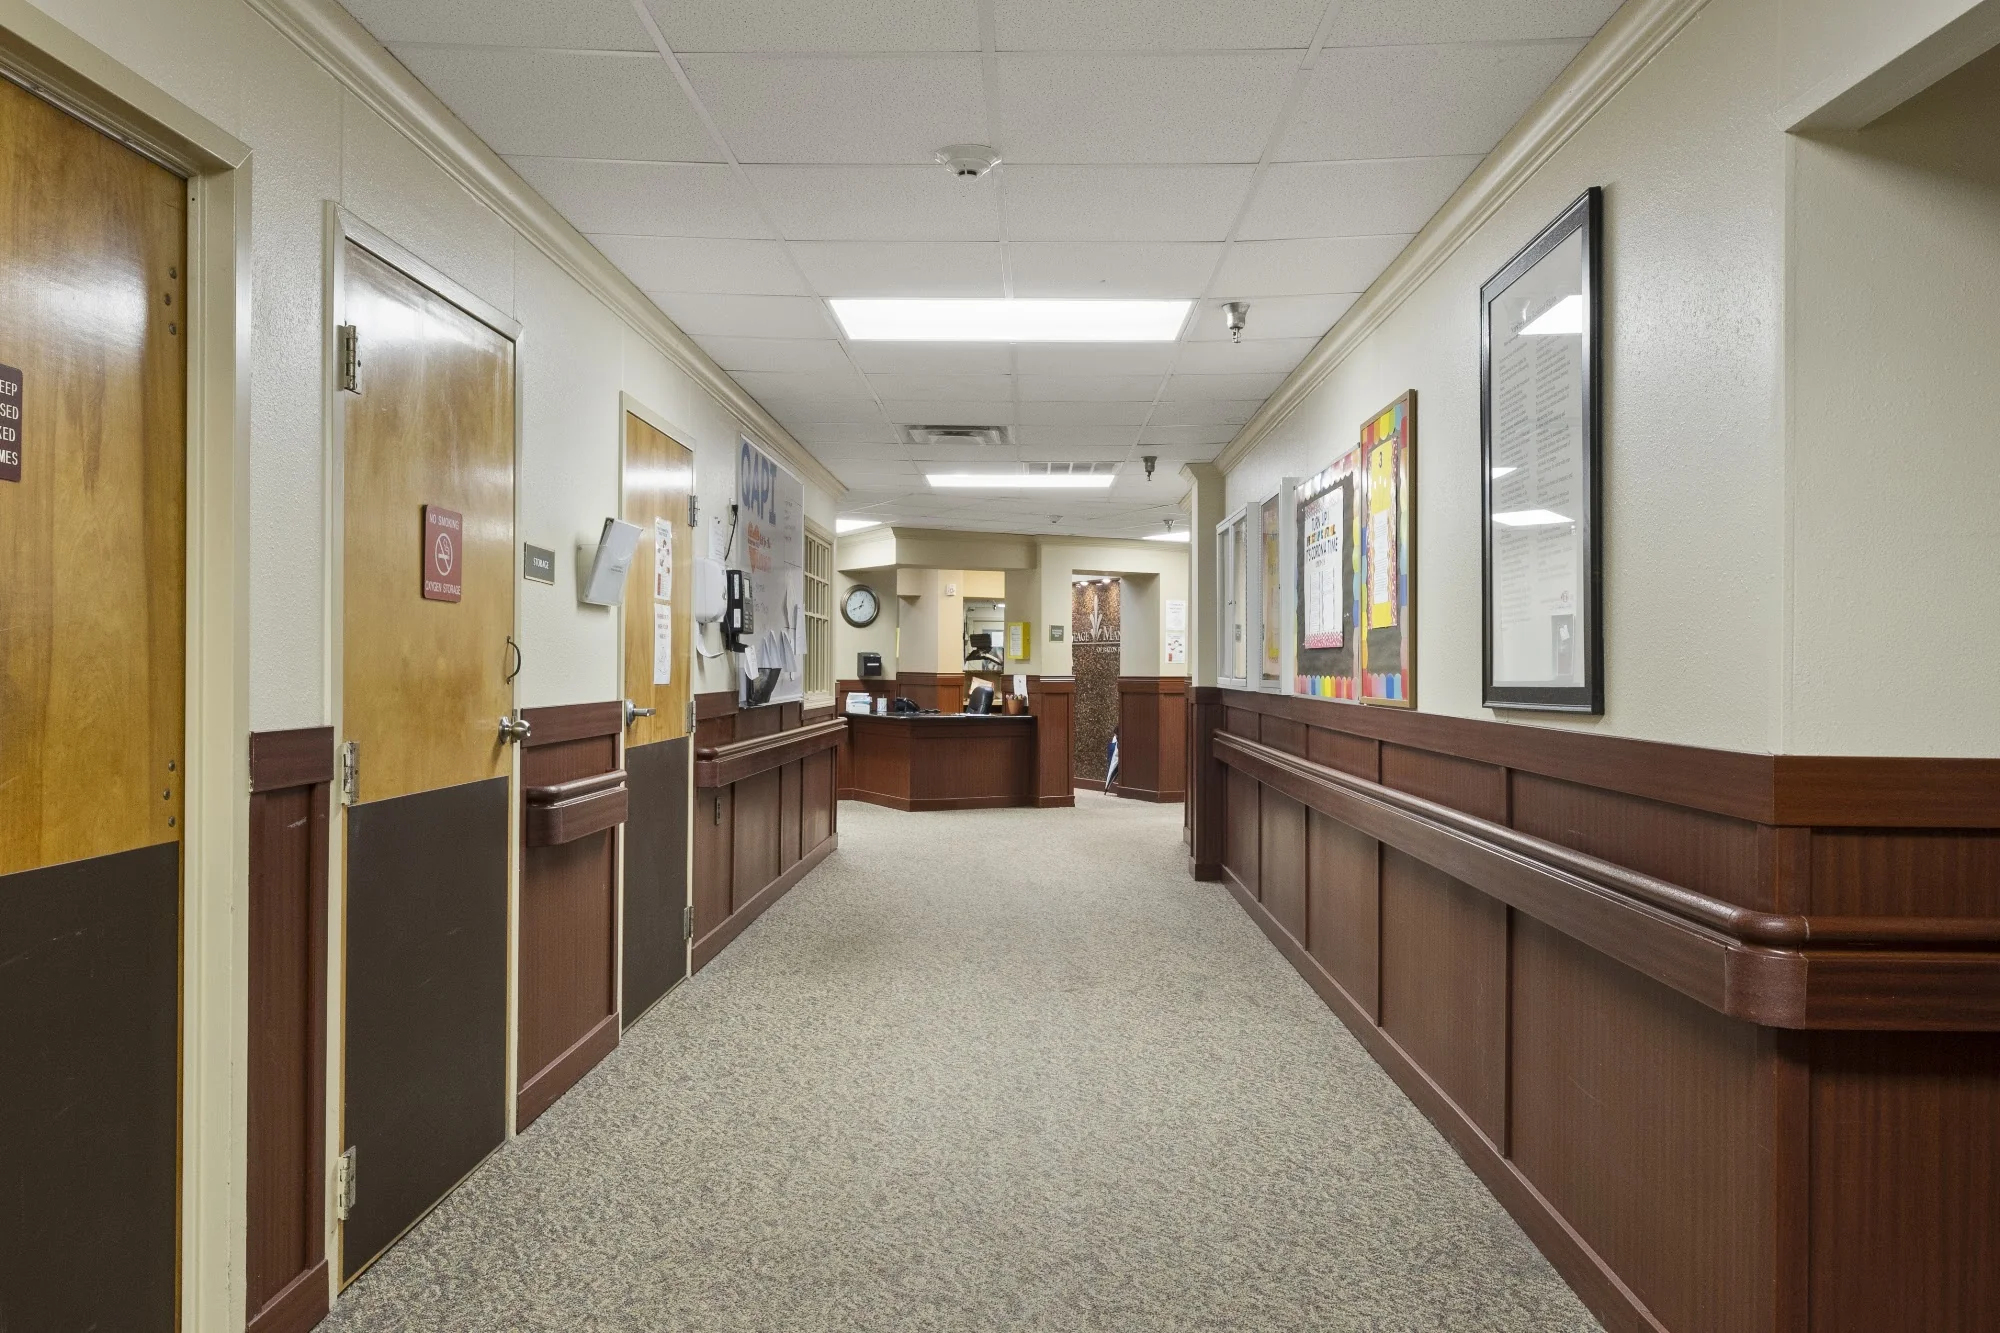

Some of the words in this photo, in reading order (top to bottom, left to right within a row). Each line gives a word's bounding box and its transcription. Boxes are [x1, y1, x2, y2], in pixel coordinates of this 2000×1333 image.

[429, 513, 437, 524] NO
[438, 515, 460, 530] SMOKING
[533, 557, 550, 570] STORAGE
[425, 580, 442, 592] OXYGEN
[443, 583, 461, 596] STORAGE
